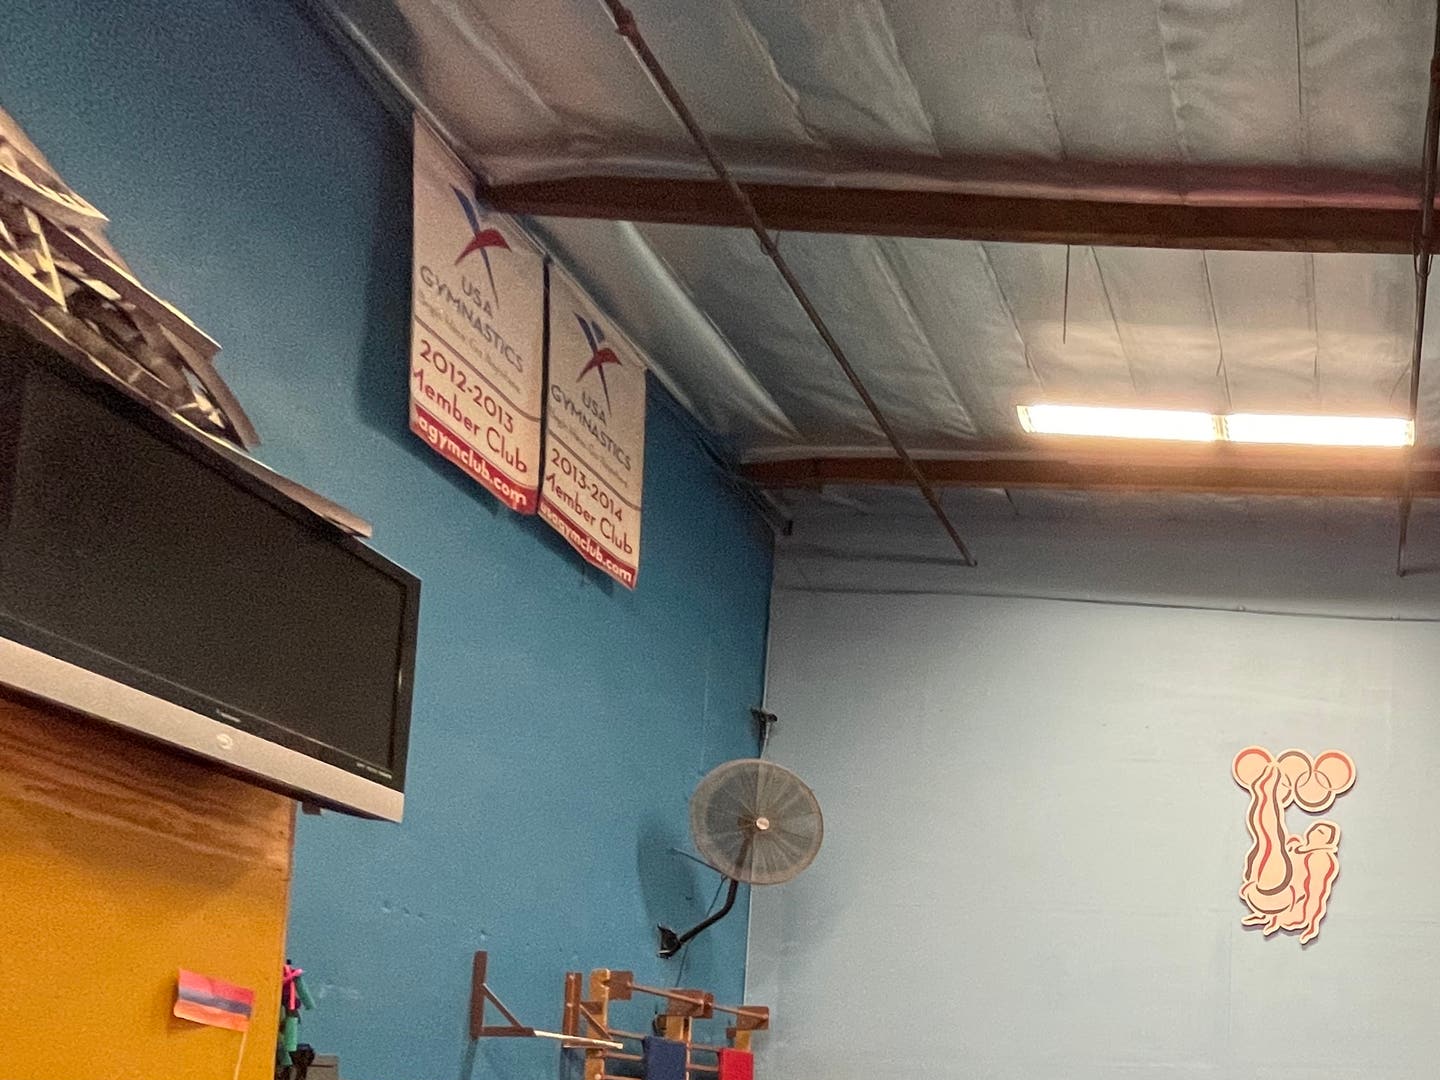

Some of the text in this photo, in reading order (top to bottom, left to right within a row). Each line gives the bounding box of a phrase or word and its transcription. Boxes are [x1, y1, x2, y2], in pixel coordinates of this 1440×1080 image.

[420, 265, 523, 373] GYMNASTICS
[462, 275, 494, 319] USA
[420, 339, 514, 434] 2012-2013
[582, 390, 607, 427] USA
[486, 426, 528, 473] Club
[551, 384, 631, 472] GYMNASTICS
[552, 448, 623, 522] 2013-2014
[600, 517, 633, 555] Club
